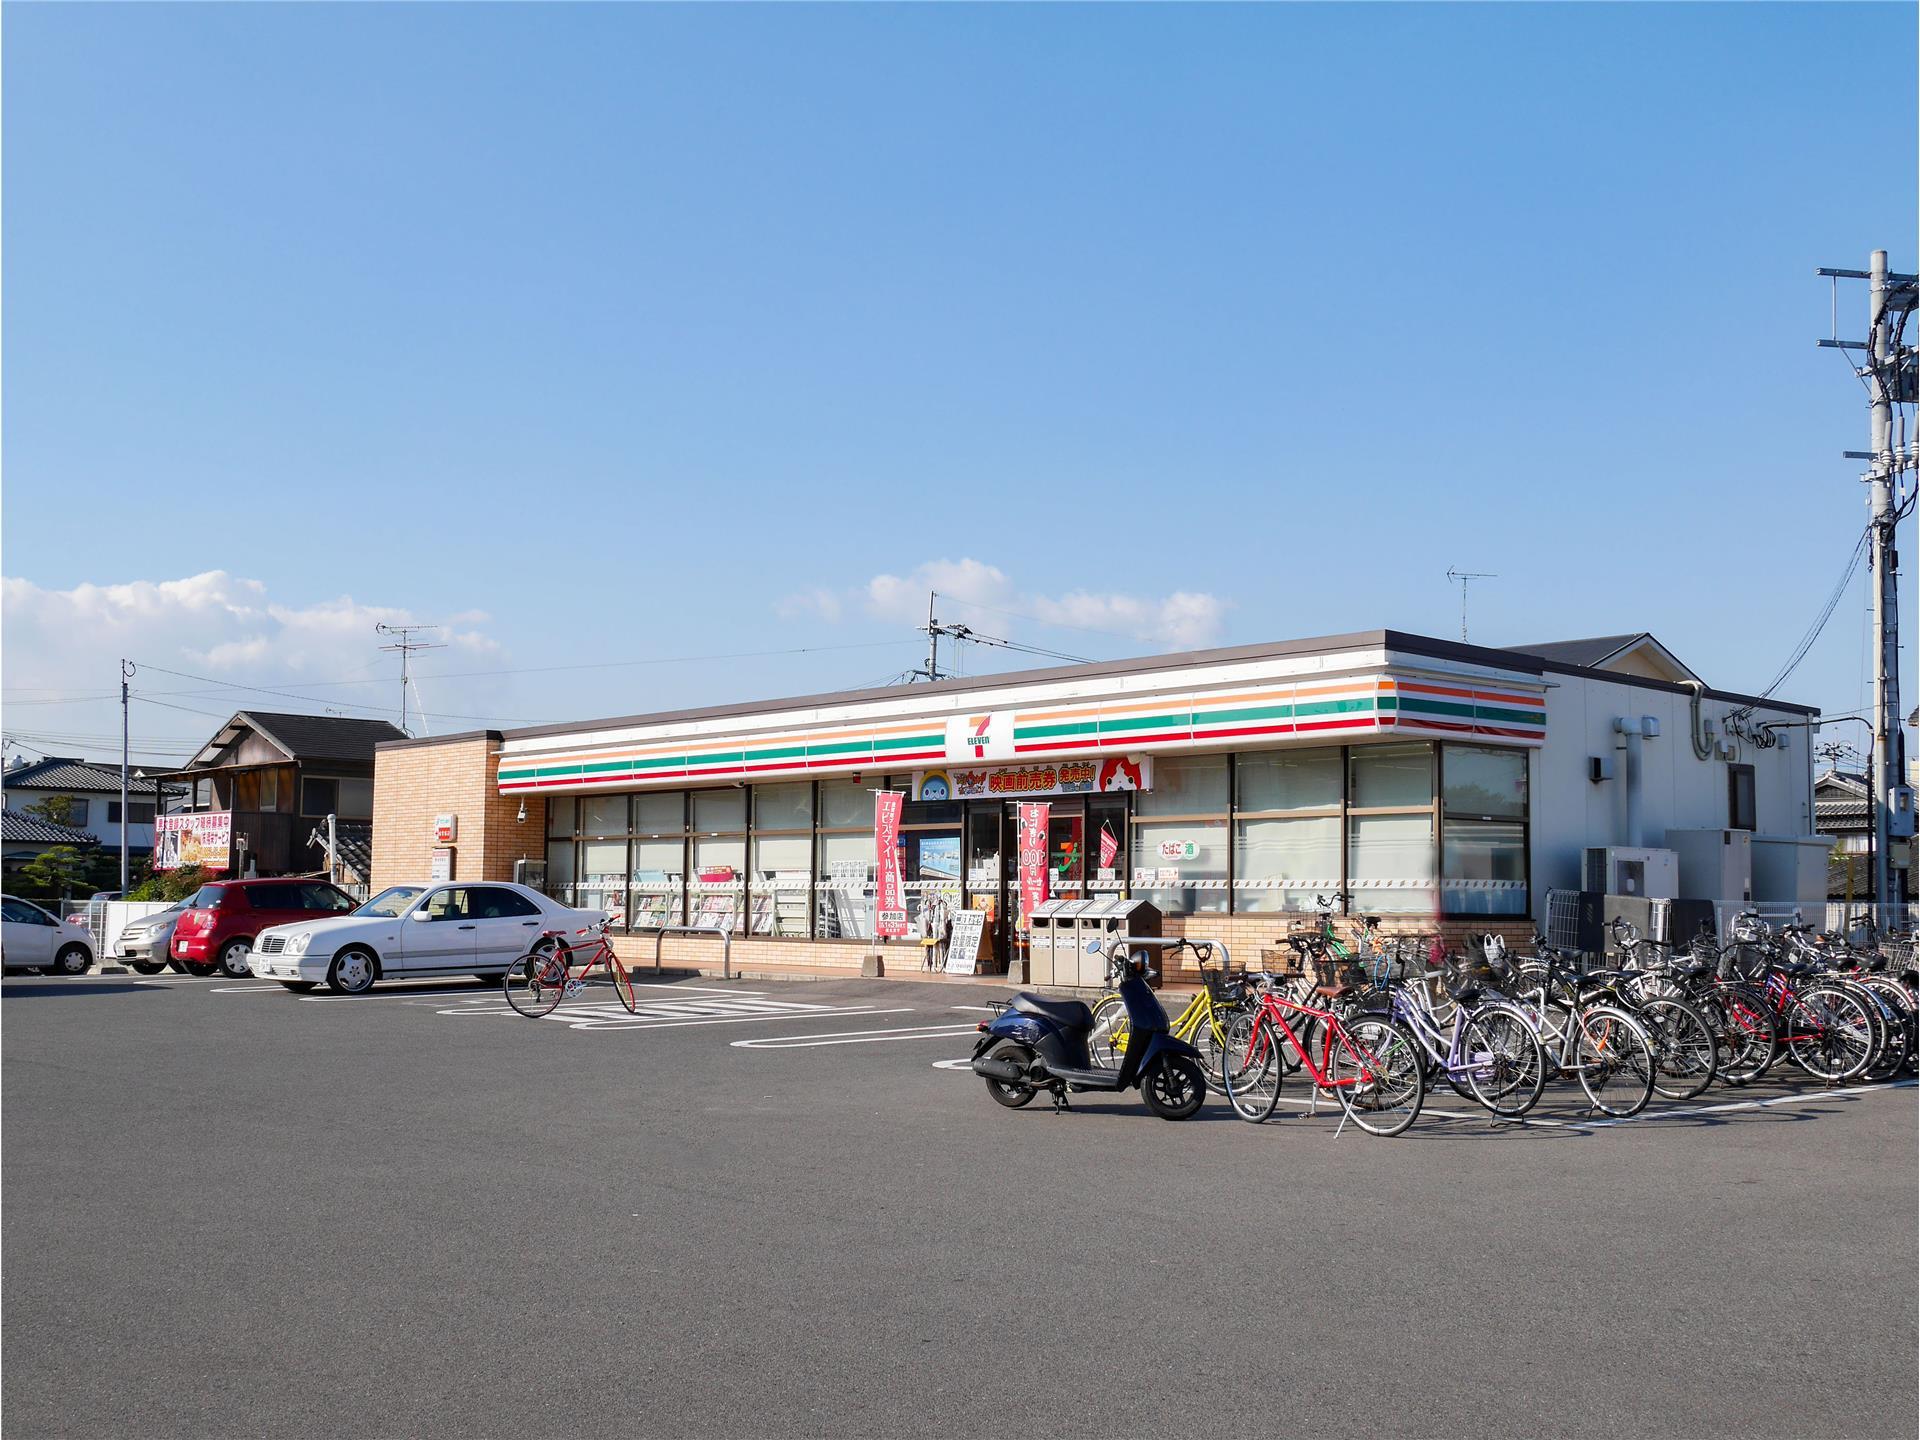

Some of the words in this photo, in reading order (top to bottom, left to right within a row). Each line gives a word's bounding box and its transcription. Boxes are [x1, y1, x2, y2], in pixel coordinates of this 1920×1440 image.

[967, 736, 990, 746] ELEVEN
[988, 770, 1057, 793] 映画前売券
[1161, 843, 1182, 855] たばこ
[1184, 842, 1194, 855] 酒
[880, 801, 897, 909] エビスマイル商品券
[881, 912, 904, 921] 参加店
